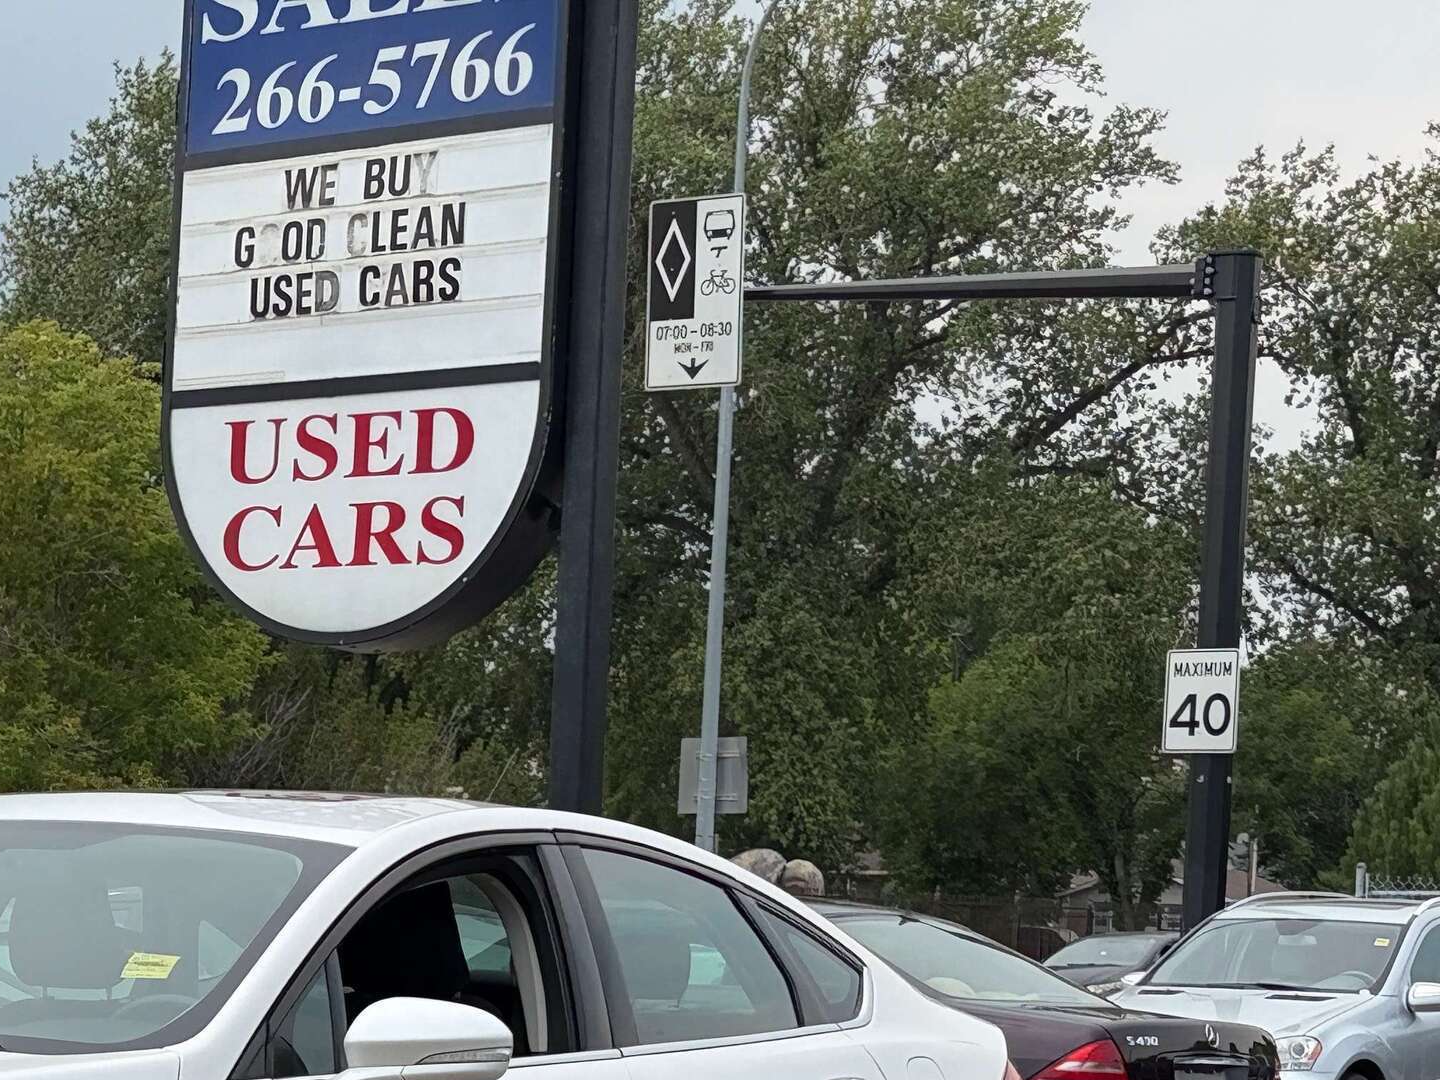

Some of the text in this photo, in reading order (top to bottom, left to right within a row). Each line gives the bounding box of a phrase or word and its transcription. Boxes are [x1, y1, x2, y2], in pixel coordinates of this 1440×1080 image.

[211, 22, 537, 136] 266-5766
[285, 151, 439, 210] WE BUY
[234, 202, 466, 268] GOD CLEAN
[250, 257, 462, 319] USED CARS
[656, 324, 688, 341] 07:00
[700, 321, 733, 338] 08:30
[224, 406, 476, 485] USED
[222, 495, 466, 573] CARS
[1173, 661, 1233, 678] MAXIMUM
[1169, 692, 1231, 737] 40
